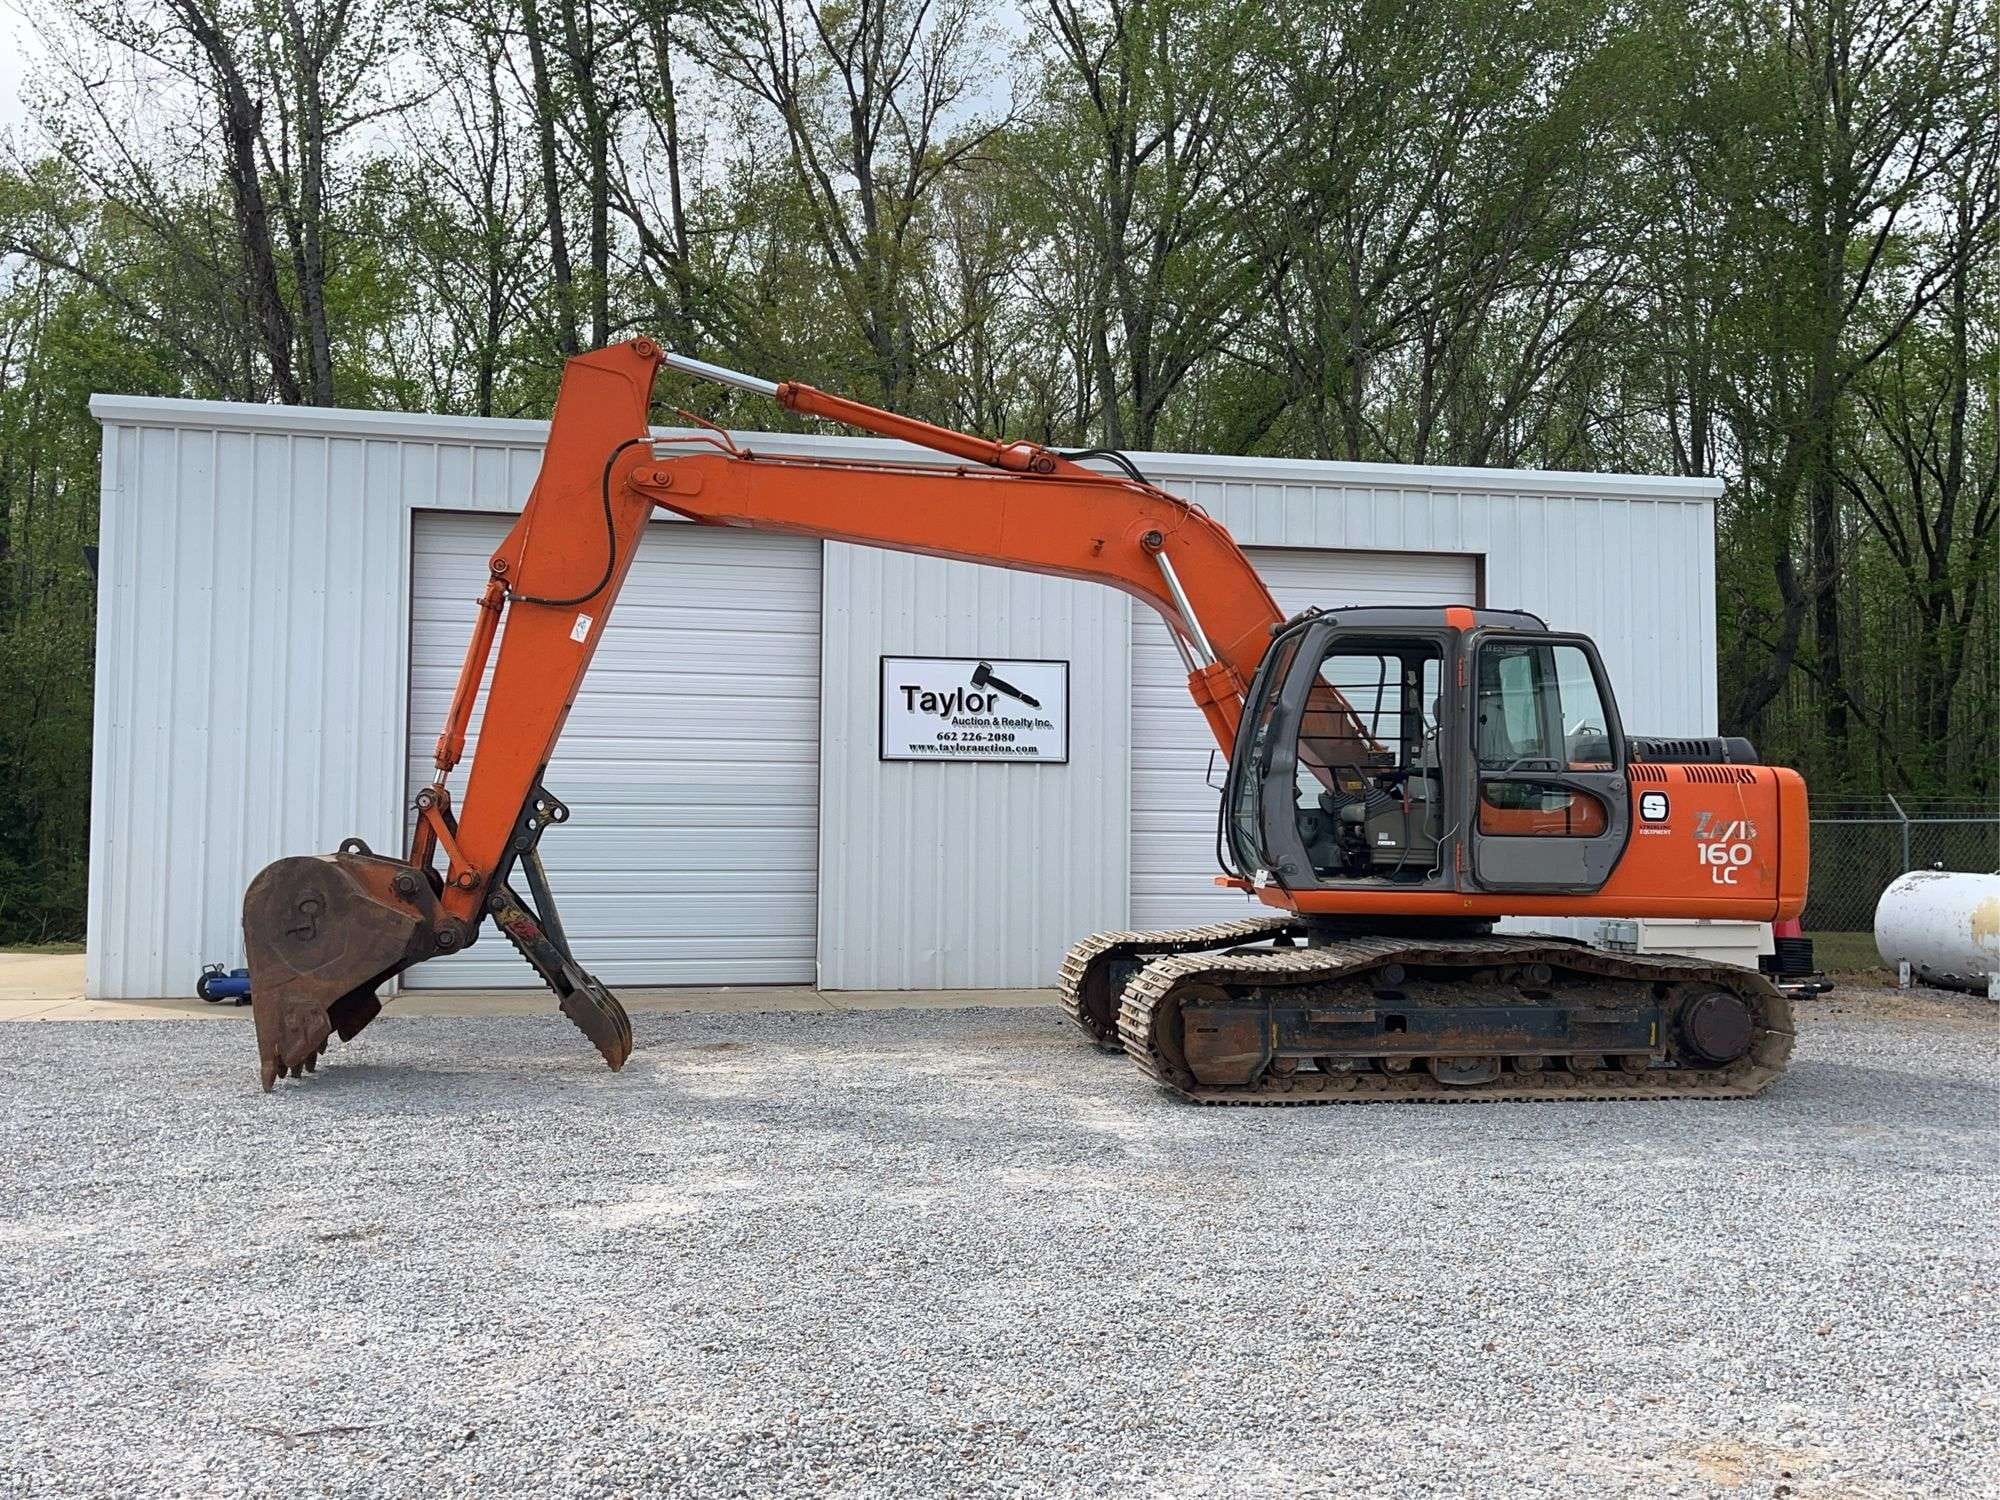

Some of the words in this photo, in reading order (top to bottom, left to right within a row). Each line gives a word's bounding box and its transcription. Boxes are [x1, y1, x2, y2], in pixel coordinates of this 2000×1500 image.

[900, 685, 998, 717] Taylor
[951, 715, 990, 726] Auction
[992, 717, 1000, 726] &
[1001, 717, 1033, 729] Realty
[1034, 718, 1053, 727] Inc.
[937, 731, 957, 741] 662
[961, 732, 1015, 742] 226-2080
[909, 743, 1038, 753] www.taylorauction.com
[1697, 843, 1753, 865] 160
[1712, 866, 1738, 884] LC
